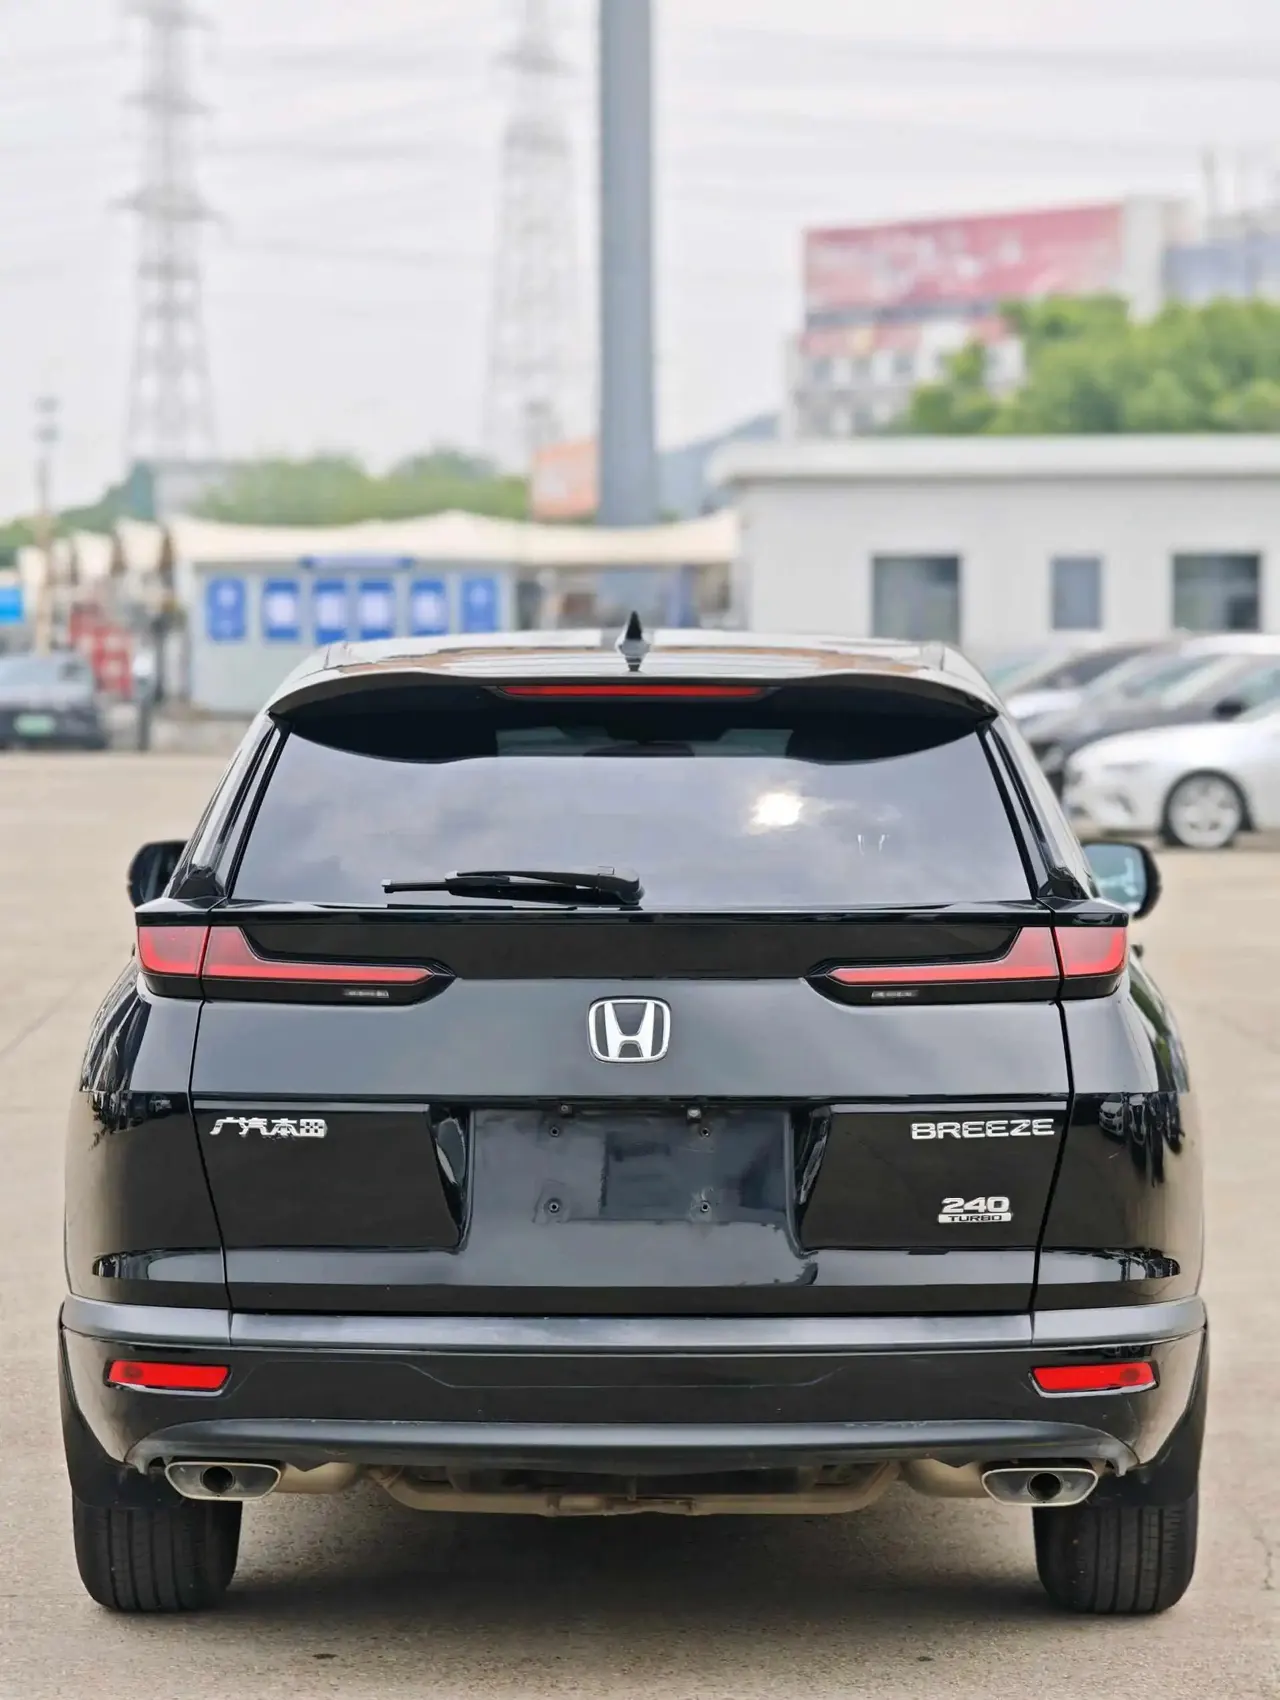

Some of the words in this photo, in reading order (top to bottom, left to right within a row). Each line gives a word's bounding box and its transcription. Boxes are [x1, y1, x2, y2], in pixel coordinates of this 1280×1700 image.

[209, 1117, 328, 1138] 广汽本田
[911, 1118, 1055, 1140] BREEZE
[941, 1196, 1010, 1213] 240
[946, 1214, 1004, 1223] TURBO
